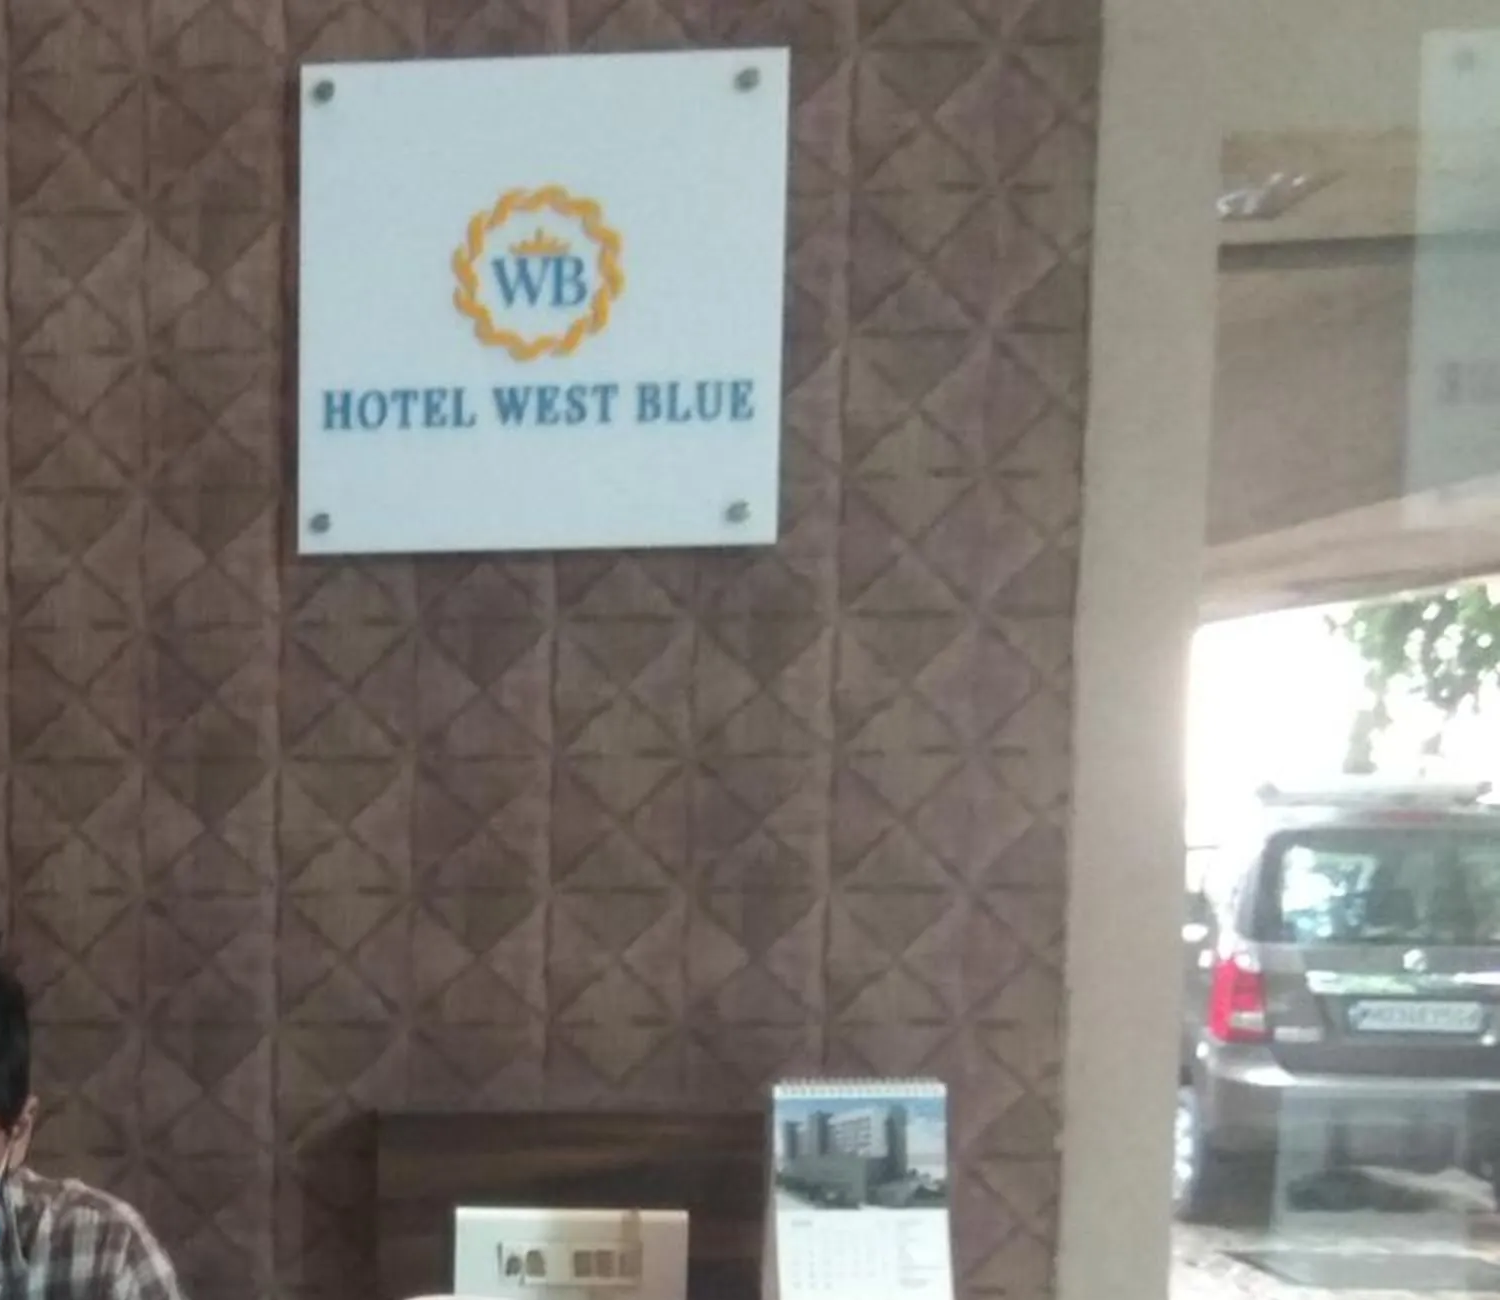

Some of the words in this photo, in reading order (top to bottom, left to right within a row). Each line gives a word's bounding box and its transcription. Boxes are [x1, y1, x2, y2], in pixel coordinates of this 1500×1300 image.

[493, 256, 587, 307] WB
[323, 388, 476, 430] HOTEL
[493, 383, 618, 425] WEST
[636, 379, 755, 423] BLUE
